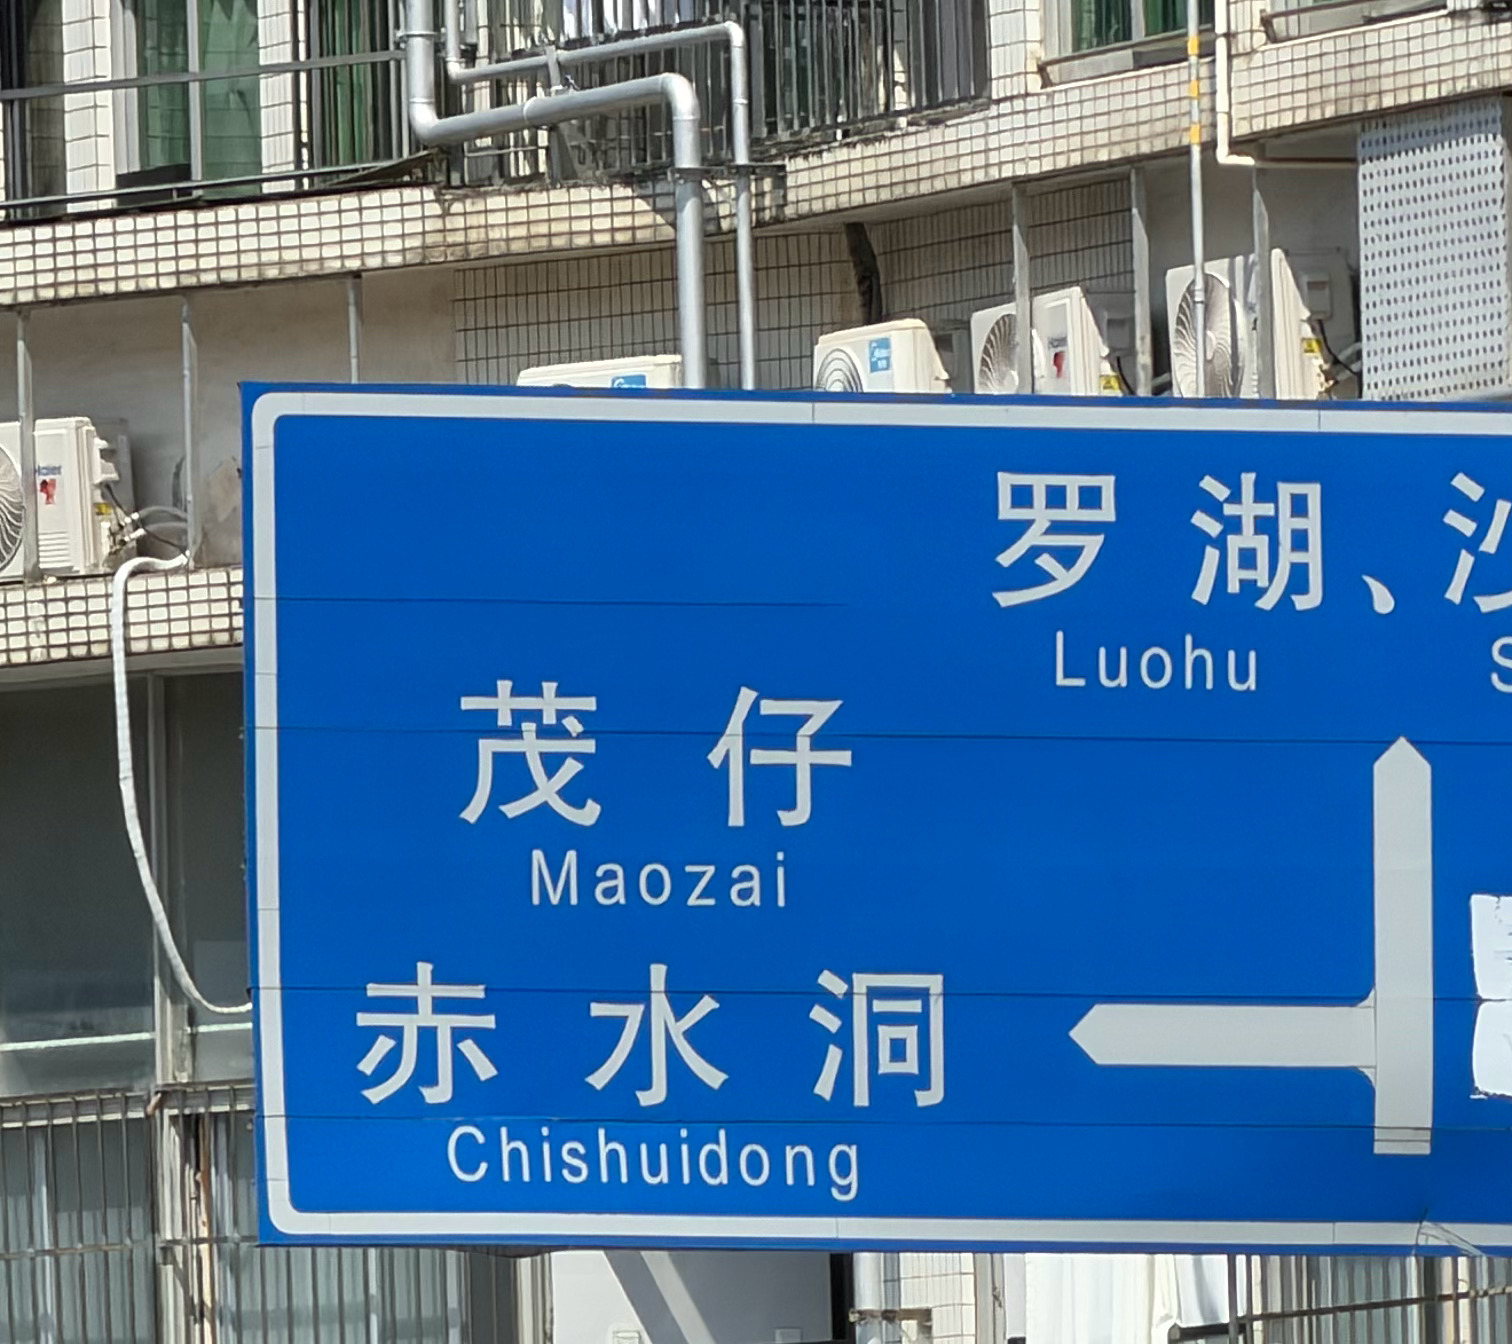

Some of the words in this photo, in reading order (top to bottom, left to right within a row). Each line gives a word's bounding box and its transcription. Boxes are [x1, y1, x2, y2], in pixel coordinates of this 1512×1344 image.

[1054, 630, 1258, 691] Luohu
[459, 679, 853, 827] 茂仔
[530, 848, 787, 908] Maozai
[355, 961, 946, 1108] 赤水洞
[446, 1125, 861, 1202] Chishuidong
